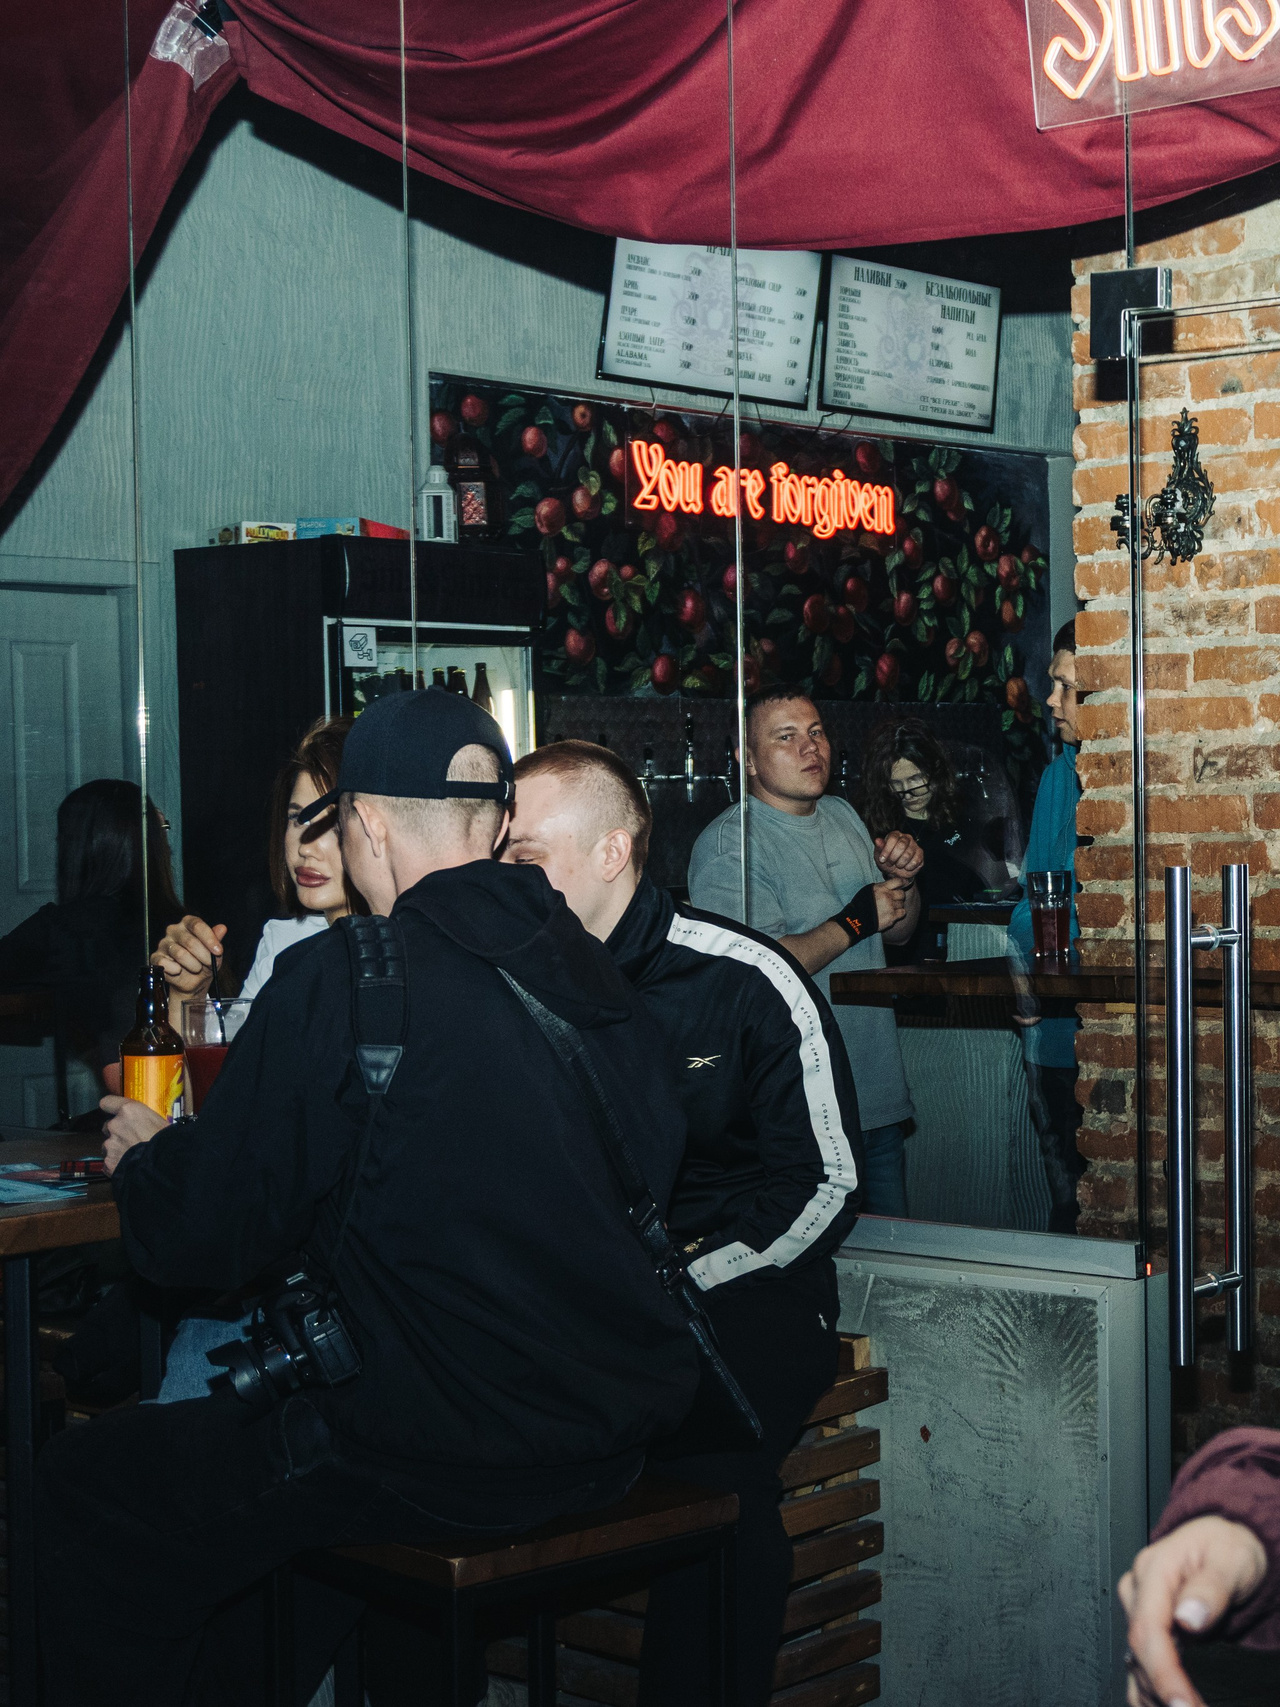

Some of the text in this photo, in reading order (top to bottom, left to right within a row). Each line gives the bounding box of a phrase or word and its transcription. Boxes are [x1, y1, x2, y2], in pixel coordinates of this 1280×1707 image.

[737, 276, 766, 289] РУКТОВЫЙ
[854, 266, 892, 288] НАЛИВКИ
[925, 281, 992, 308] БЕЗАЛКОГОЛЬНЫЕ
[940, 304, 976, 325] НАПИТКИ
[616, 348, 648, 361] ALABAMA
[632, 439, 896, 540] You are forgiven
[245, 526, 289, 541] HOLLYWOOD
[808, 1042, 820, 1073] COMBAT
[821, 1103, 843, 1177] CONOR MCGREGOR
[801, 1212, 821, 1240] COMBAT
